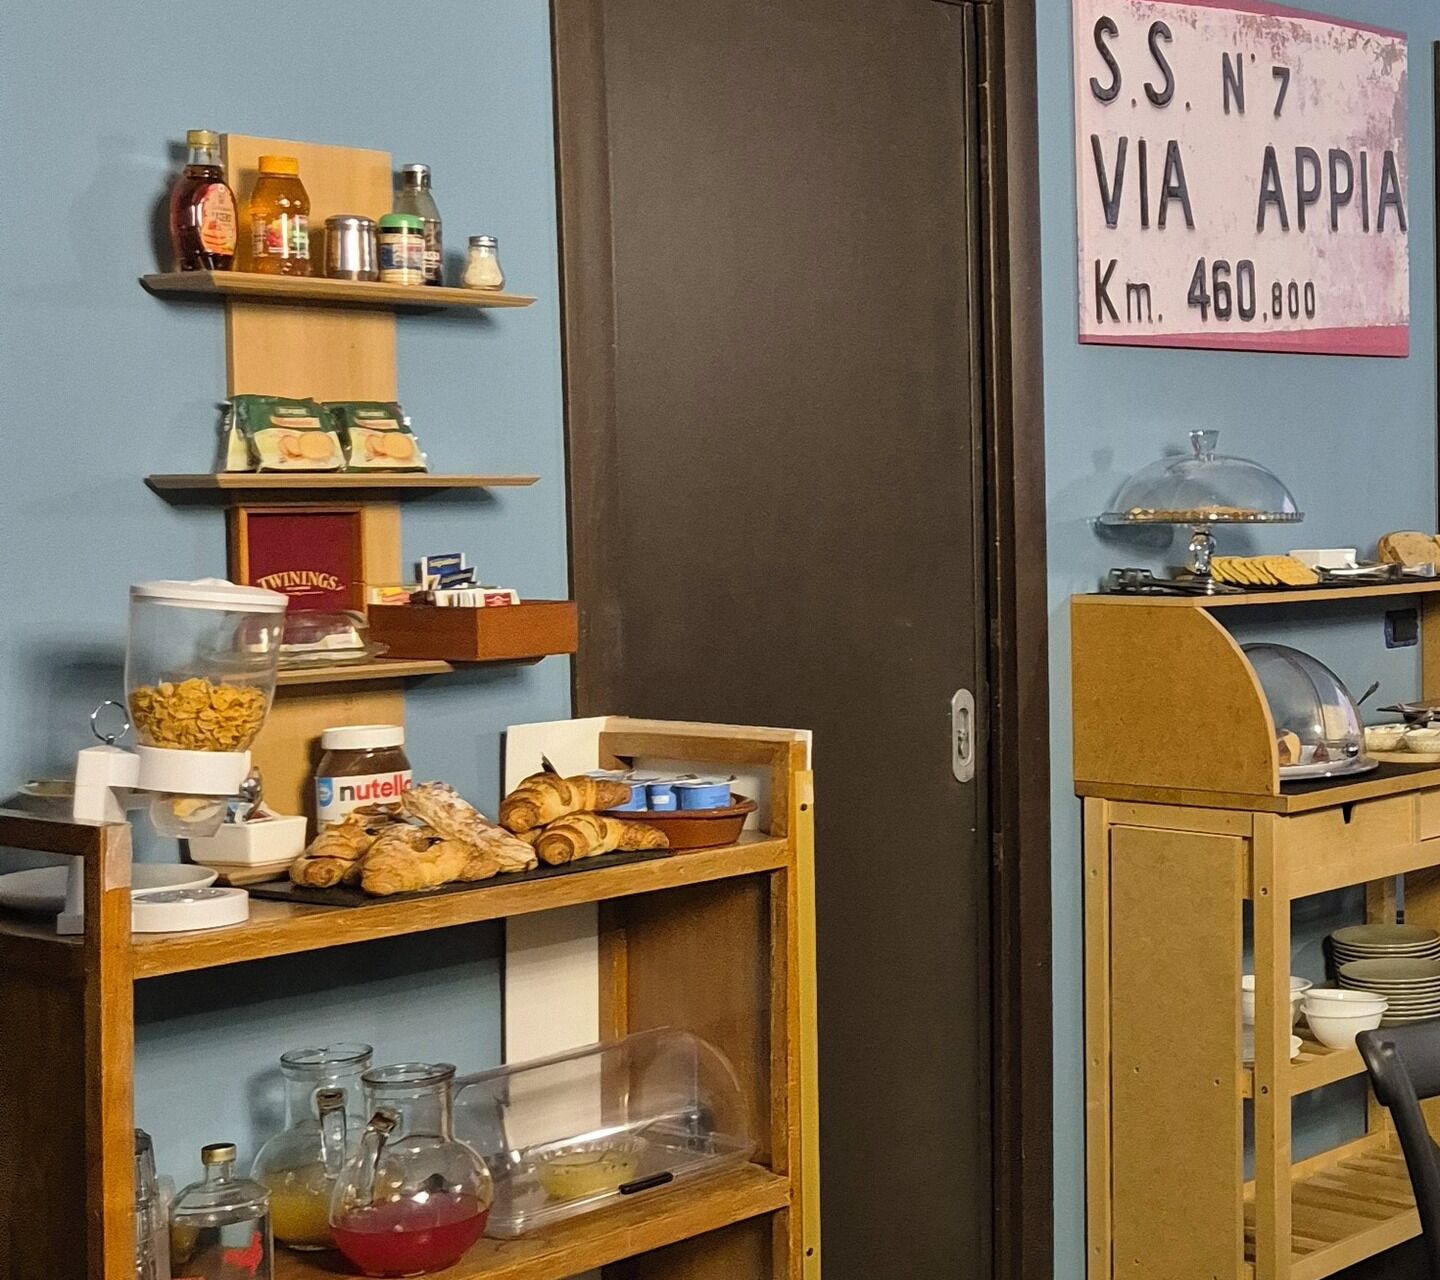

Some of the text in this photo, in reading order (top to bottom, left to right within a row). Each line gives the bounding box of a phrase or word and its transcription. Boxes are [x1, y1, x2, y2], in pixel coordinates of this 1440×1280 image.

[1271, 65, 1290, 119] 7
[1090, 133, 1407, 233] VIA APPIA
[1095, 258, 1163, 324] Km.
[256, 570, 339, 591] TWININGS
